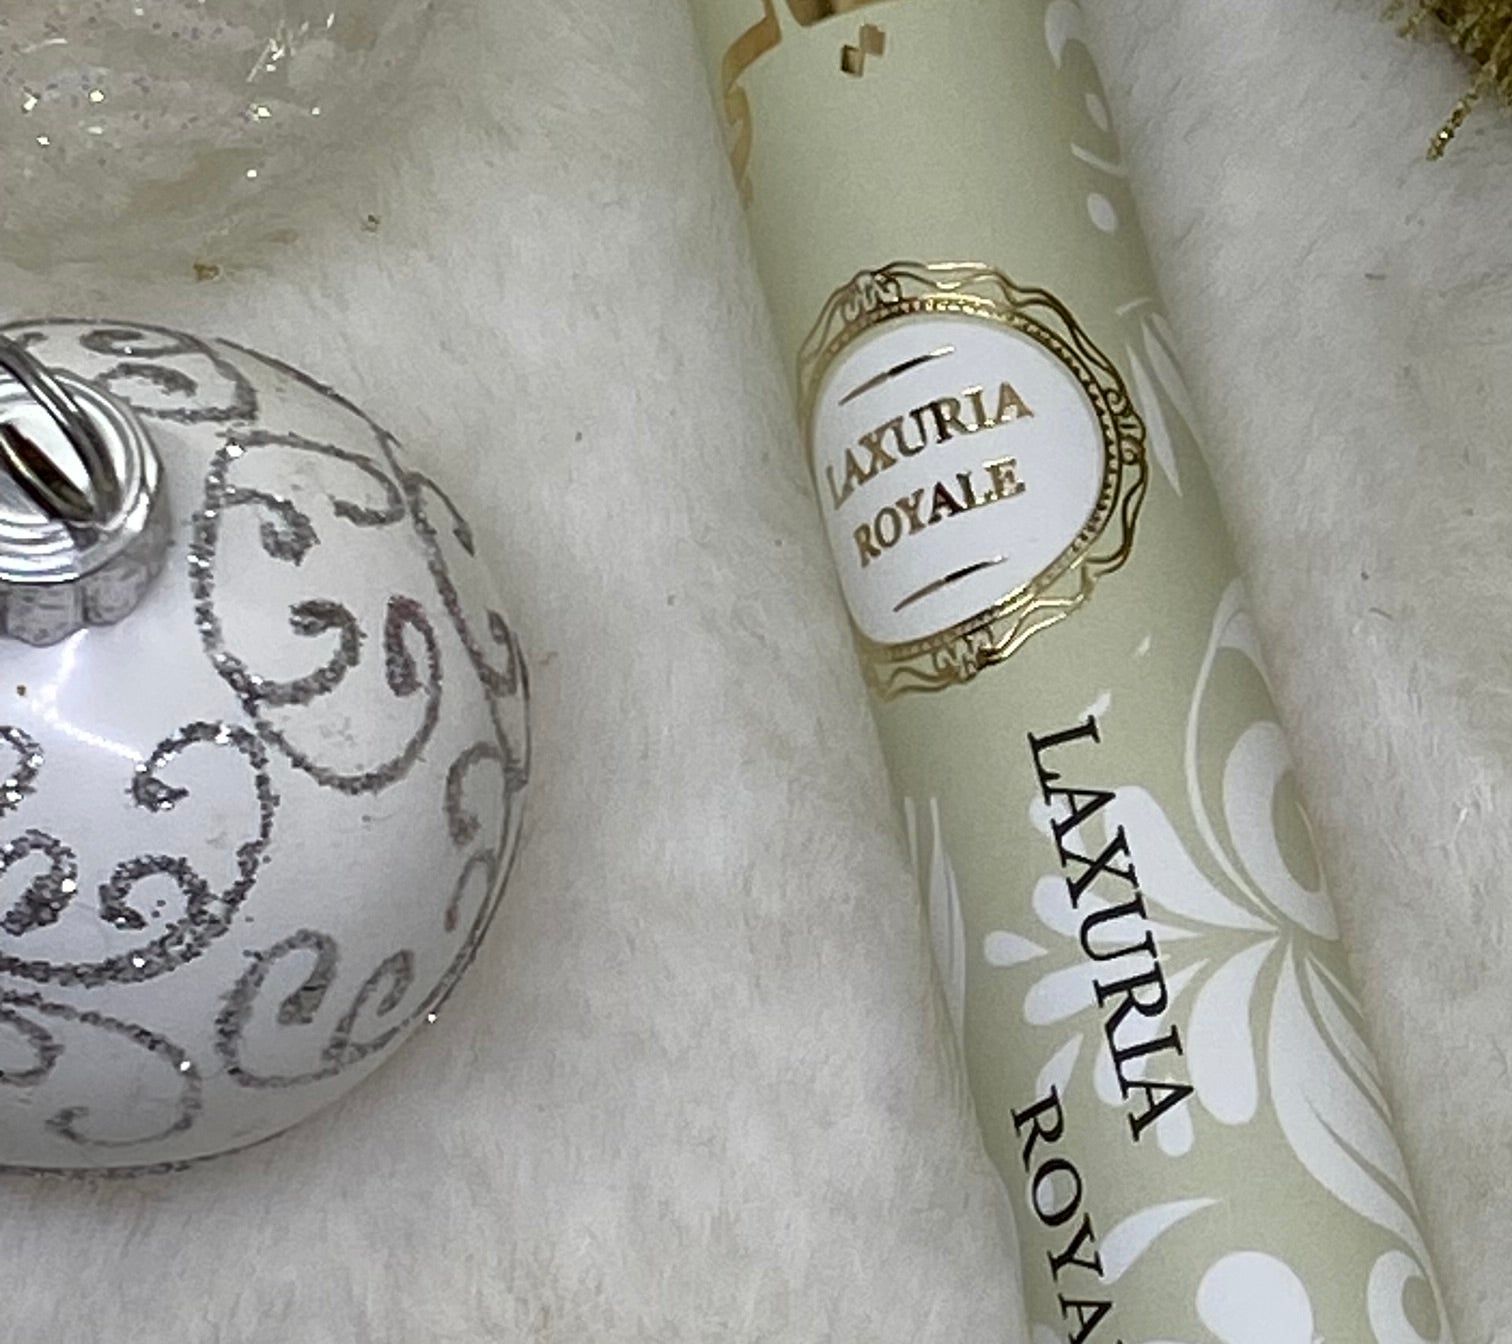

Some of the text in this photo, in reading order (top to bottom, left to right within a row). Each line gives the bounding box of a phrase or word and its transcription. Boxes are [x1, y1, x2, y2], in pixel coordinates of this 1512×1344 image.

[825, 381, 1034, 510] LAXURIA
[852, 456, 1026, 568] ROYALE
[1026, 714, 1195, 1144] LAXURIA
